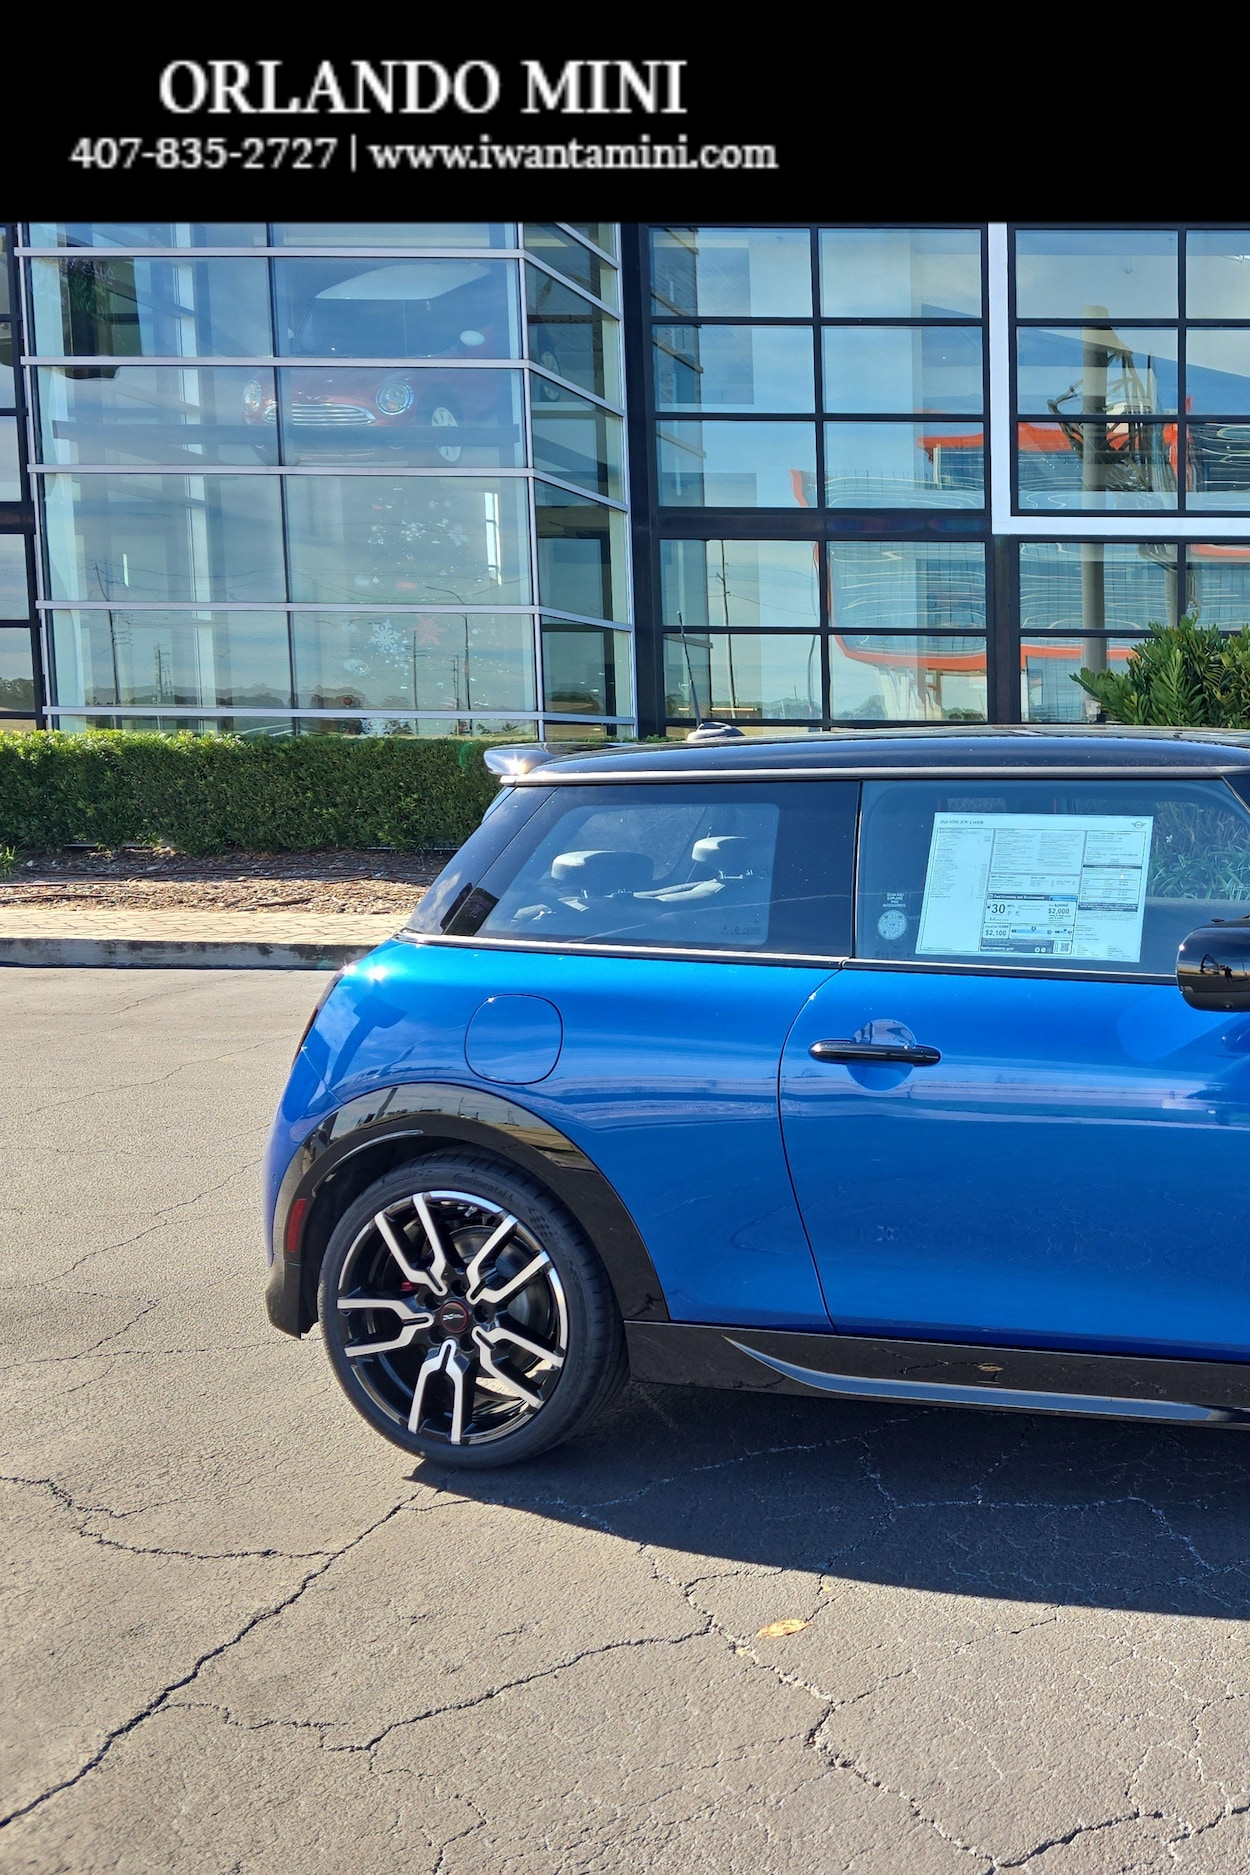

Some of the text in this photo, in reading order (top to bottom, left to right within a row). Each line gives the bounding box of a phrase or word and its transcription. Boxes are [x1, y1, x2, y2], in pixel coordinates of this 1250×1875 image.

[991, 903, 1006, 914] 30
[1048, 907, 1070, 915] $2,000
[985, 929, 1007, 937] $2,100
